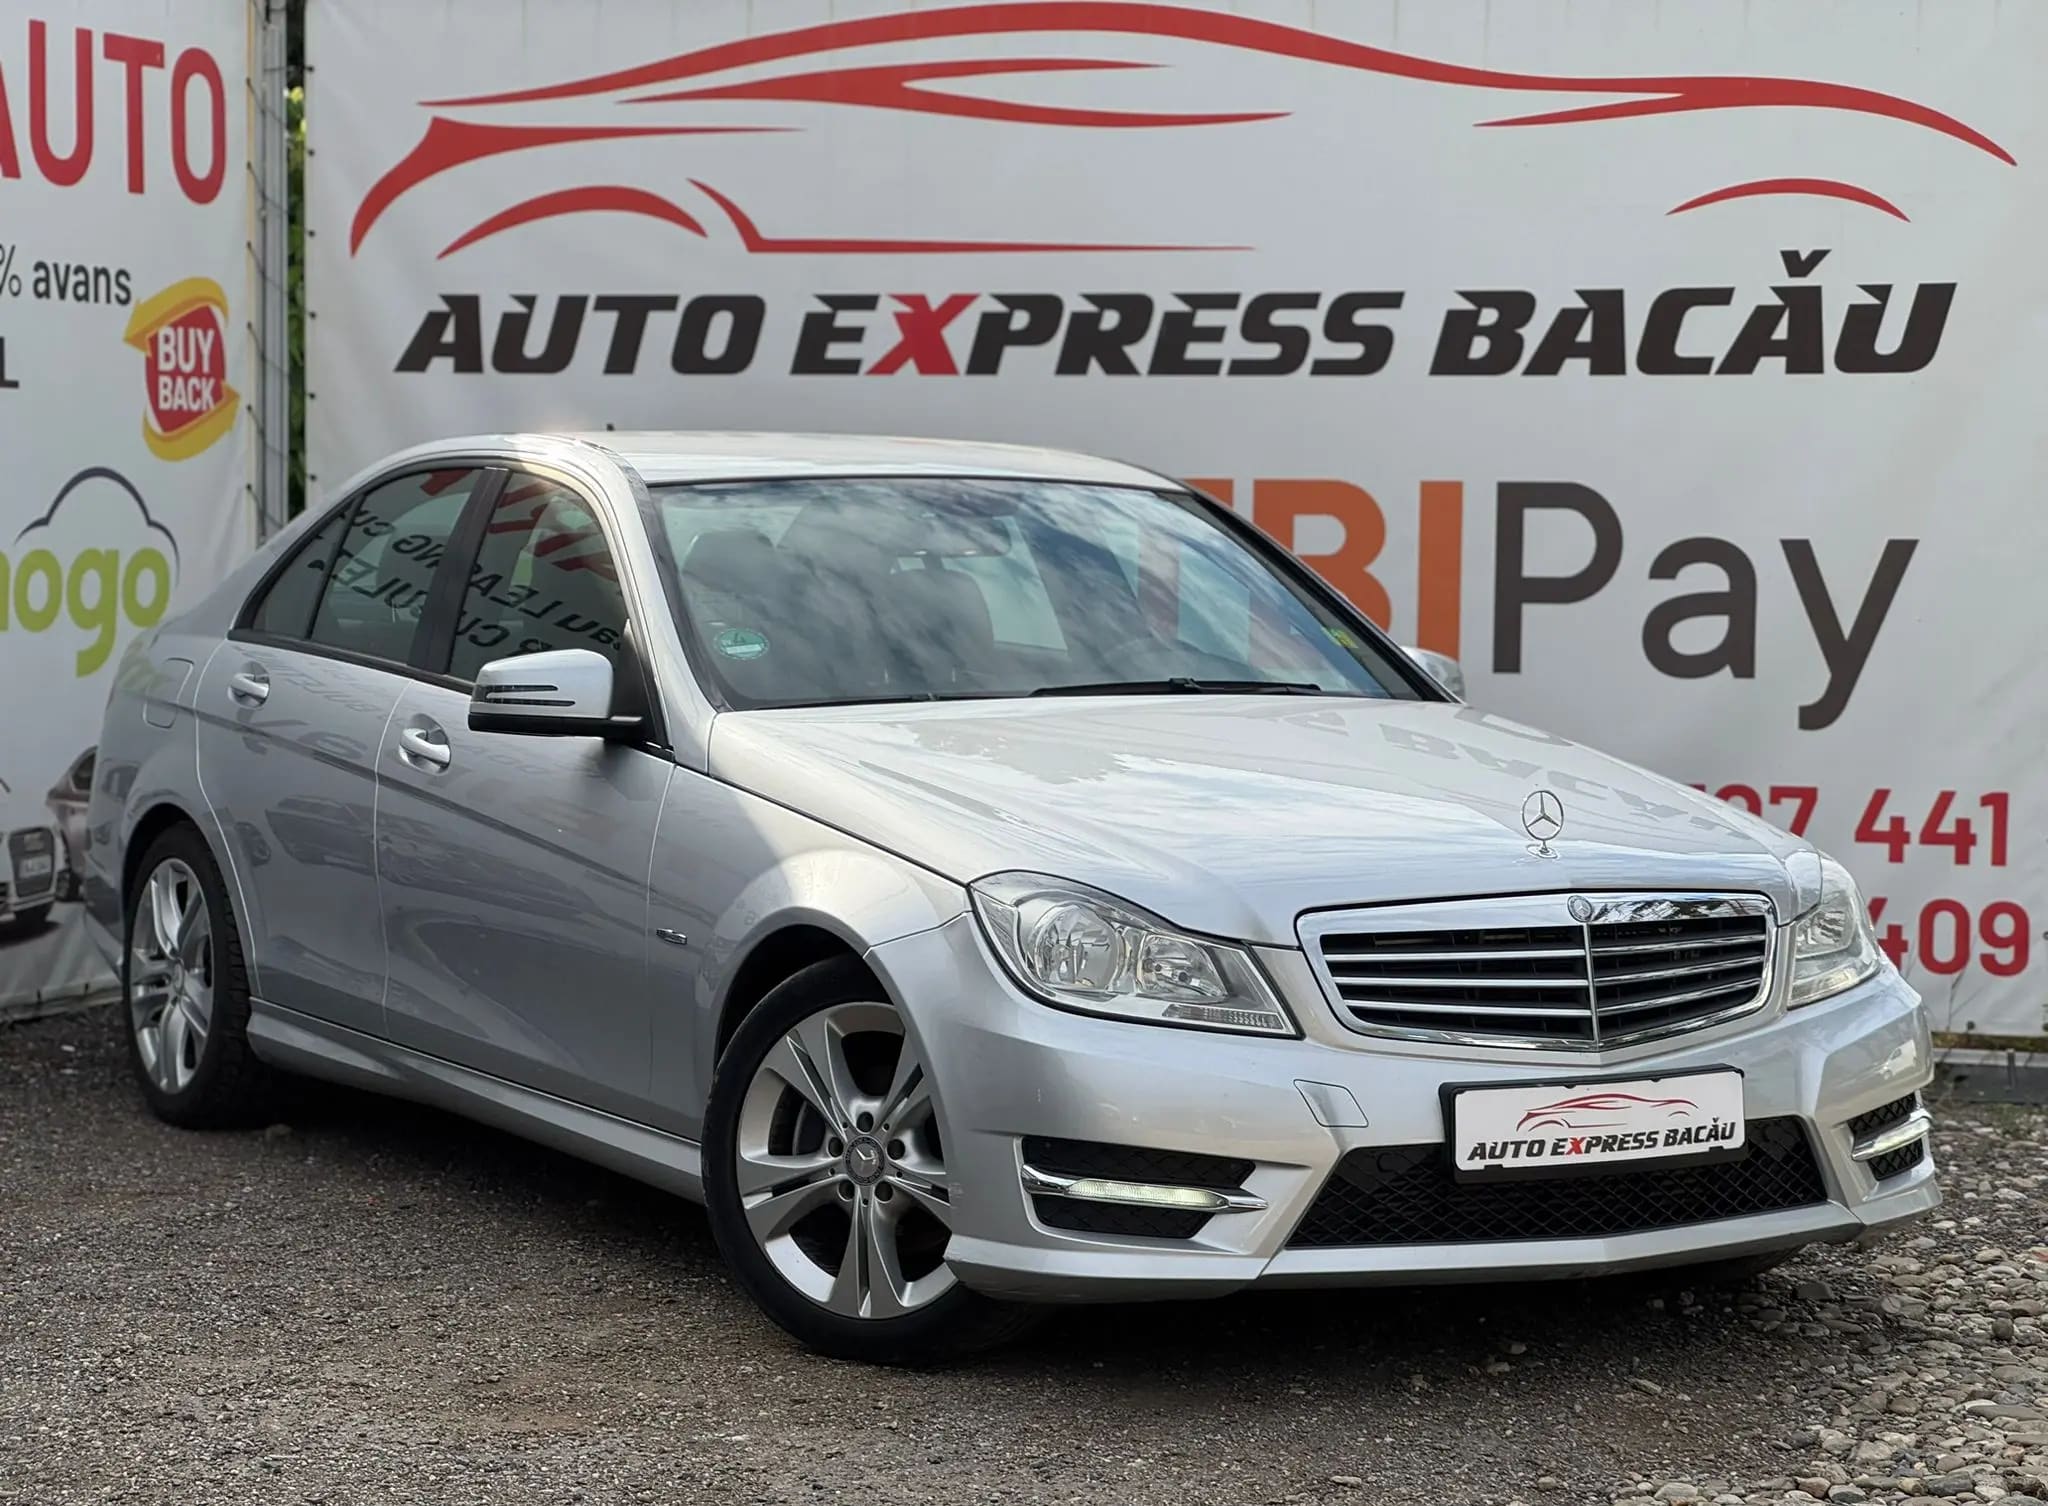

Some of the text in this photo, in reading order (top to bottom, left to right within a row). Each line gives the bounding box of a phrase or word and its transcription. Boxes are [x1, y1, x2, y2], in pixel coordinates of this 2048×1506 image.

[33, 260, 132, 305] avans
[393, 249, 1958, 377] AUTO EXPRESS BACĂU
[157, 326, 215, 372] BUY
[158, 376, 216, 411] BACK
[0, 547, 170, 677] ogo
[1854, 787, 2010, 867] 441
[1467, 1116, 1736, 1160] AUTO EXPRESS BACĂU
